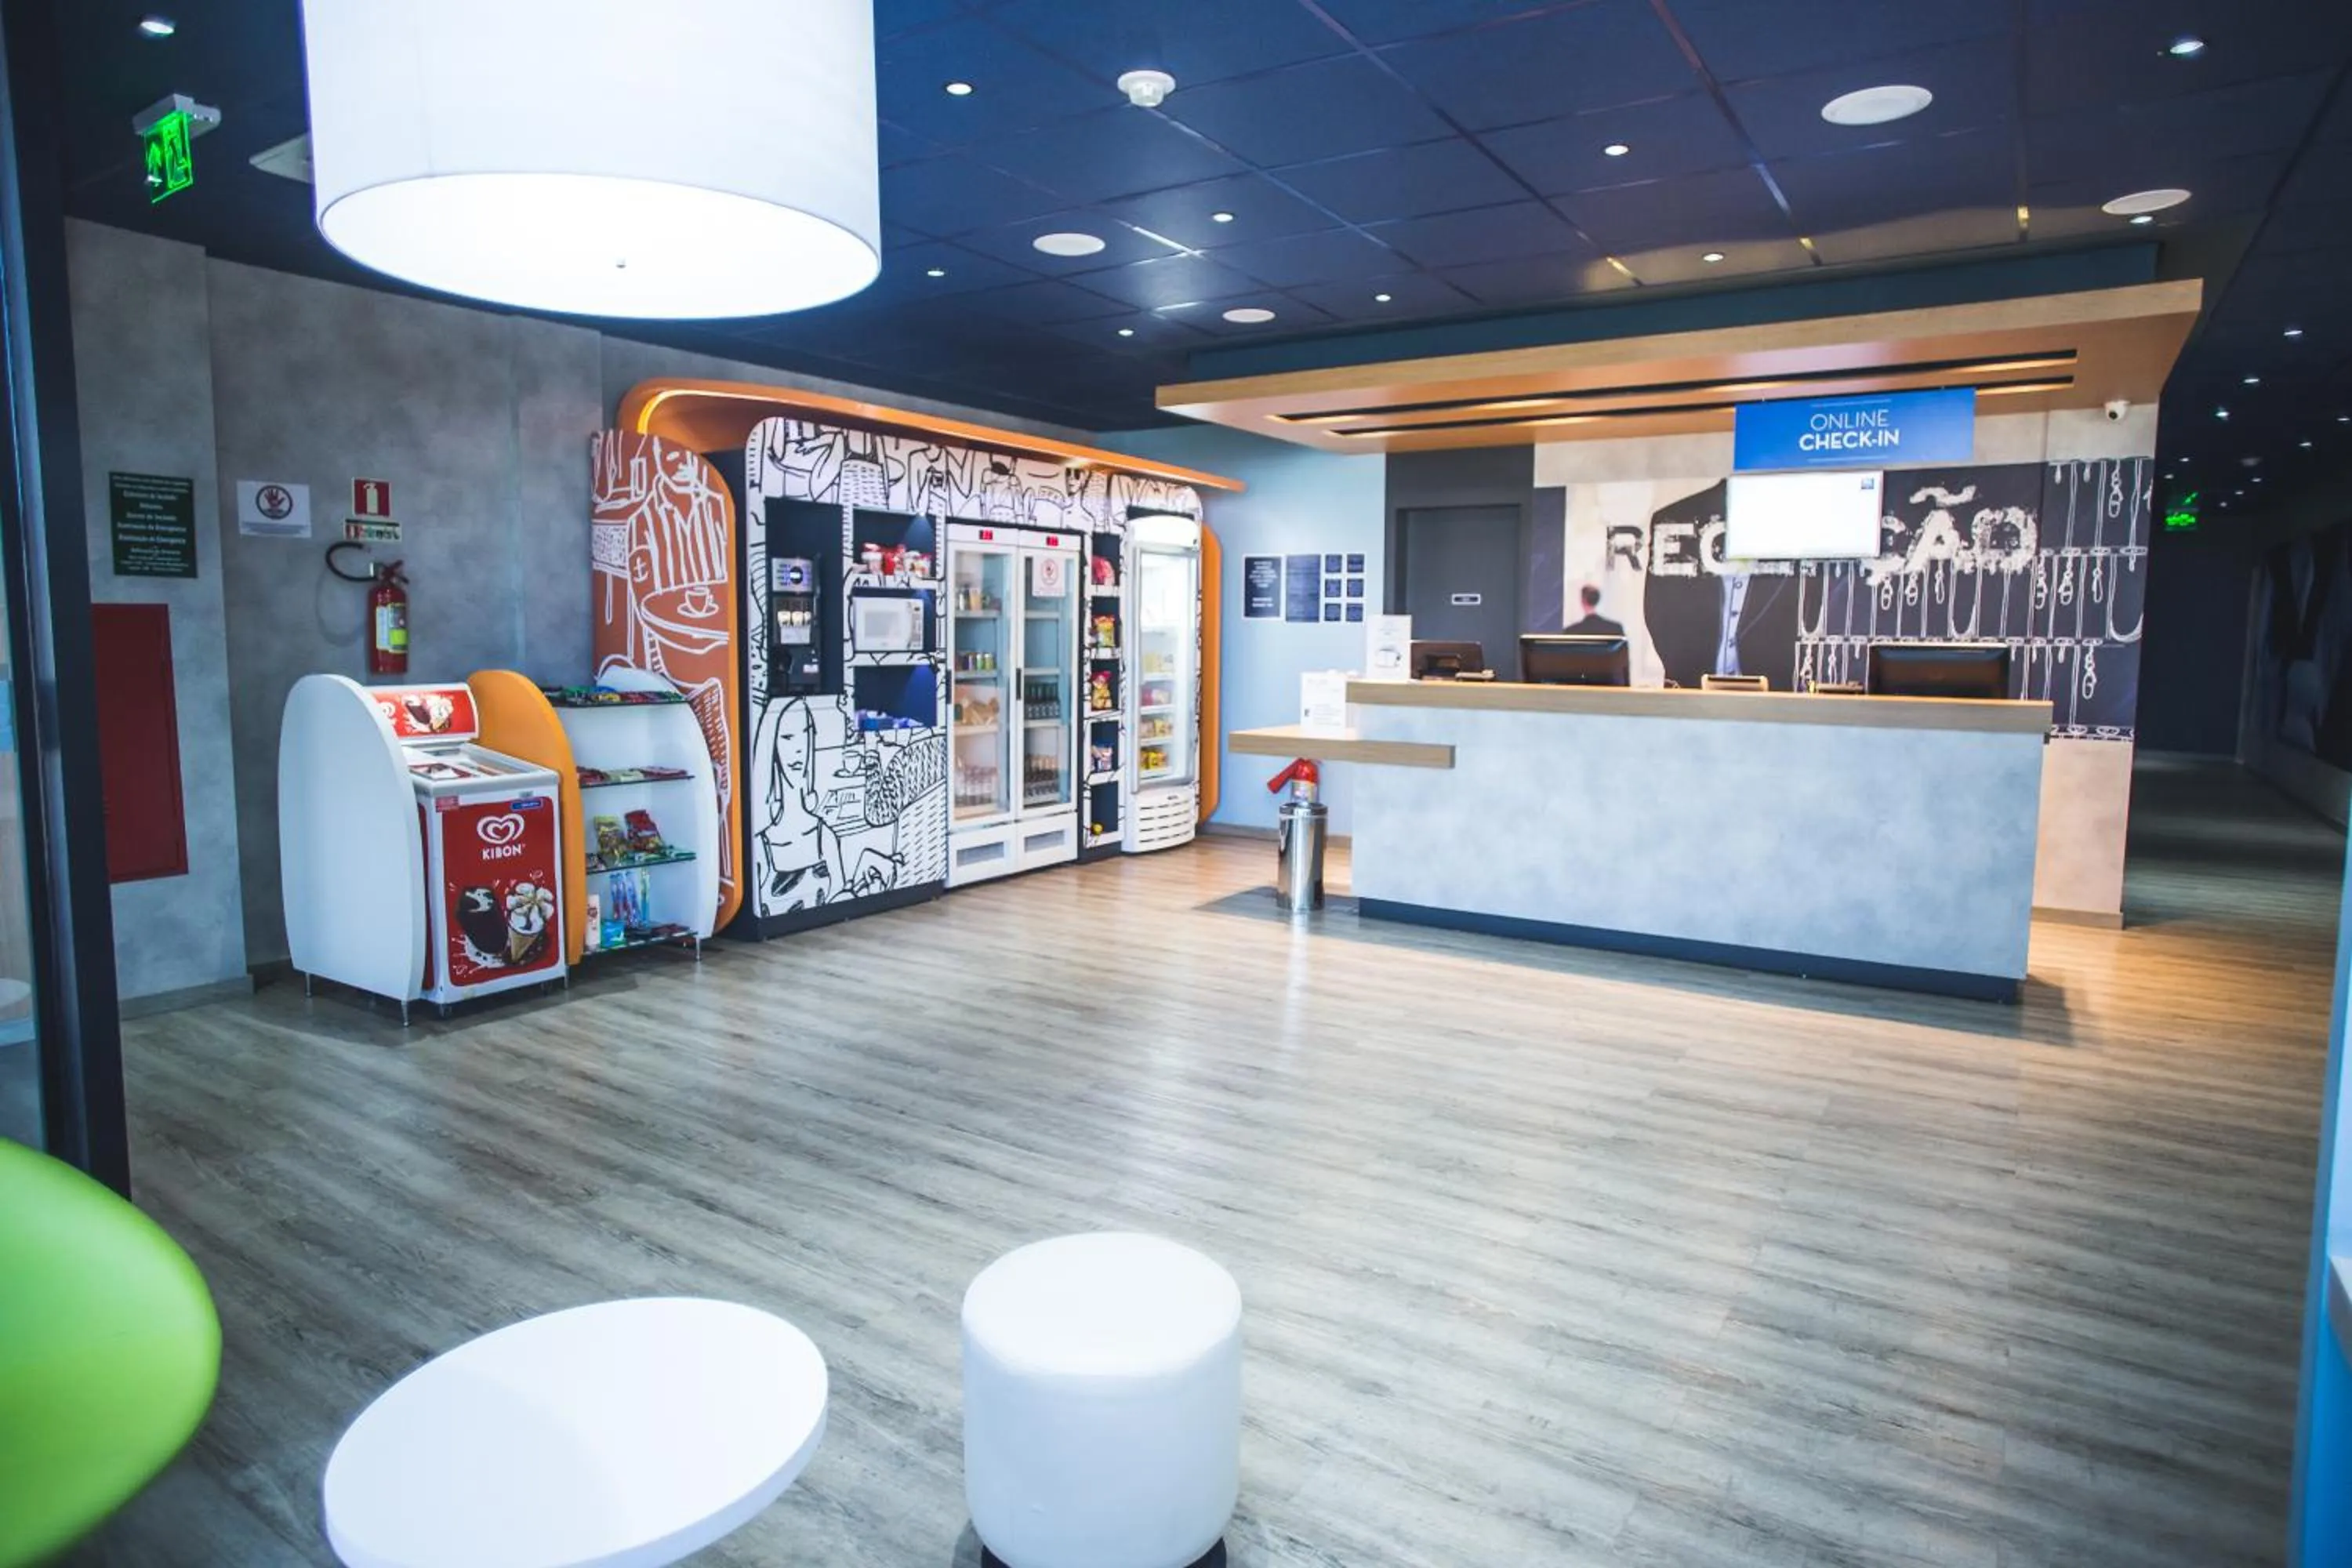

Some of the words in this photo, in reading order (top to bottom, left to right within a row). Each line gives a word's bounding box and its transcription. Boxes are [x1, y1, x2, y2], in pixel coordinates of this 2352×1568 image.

[1809, 408, 1890, 431] ONLINE
[1798, 428, 1900, 452] CHECK-IN
[1606, 485, 2038, 586] RECÇÃO
[482, 844, 521, 860] KIBON
